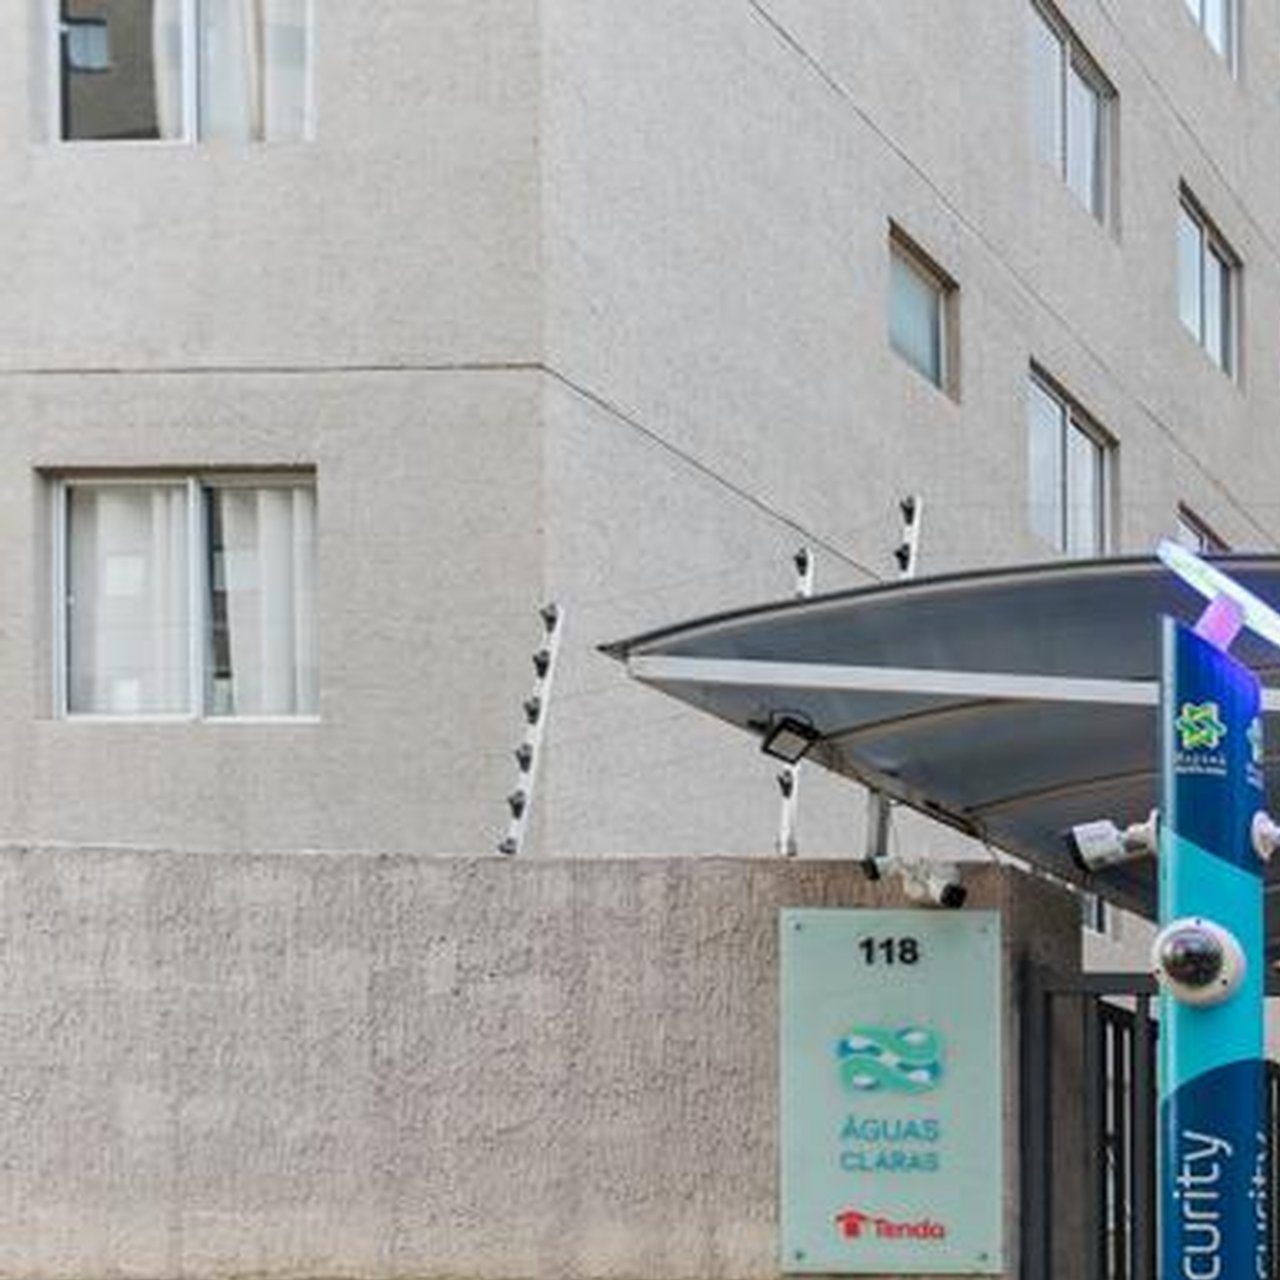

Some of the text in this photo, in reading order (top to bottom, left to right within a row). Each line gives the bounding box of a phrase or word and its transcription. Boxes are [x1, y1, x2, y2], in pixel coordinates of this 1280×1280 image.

[859, 938, 919, 965] 118
[842, 1114, 940, 1142] ÁGUAS
[840, 1153, 940, 1171] CLARAS
[875, 1217, 946, 1240] Tenda
